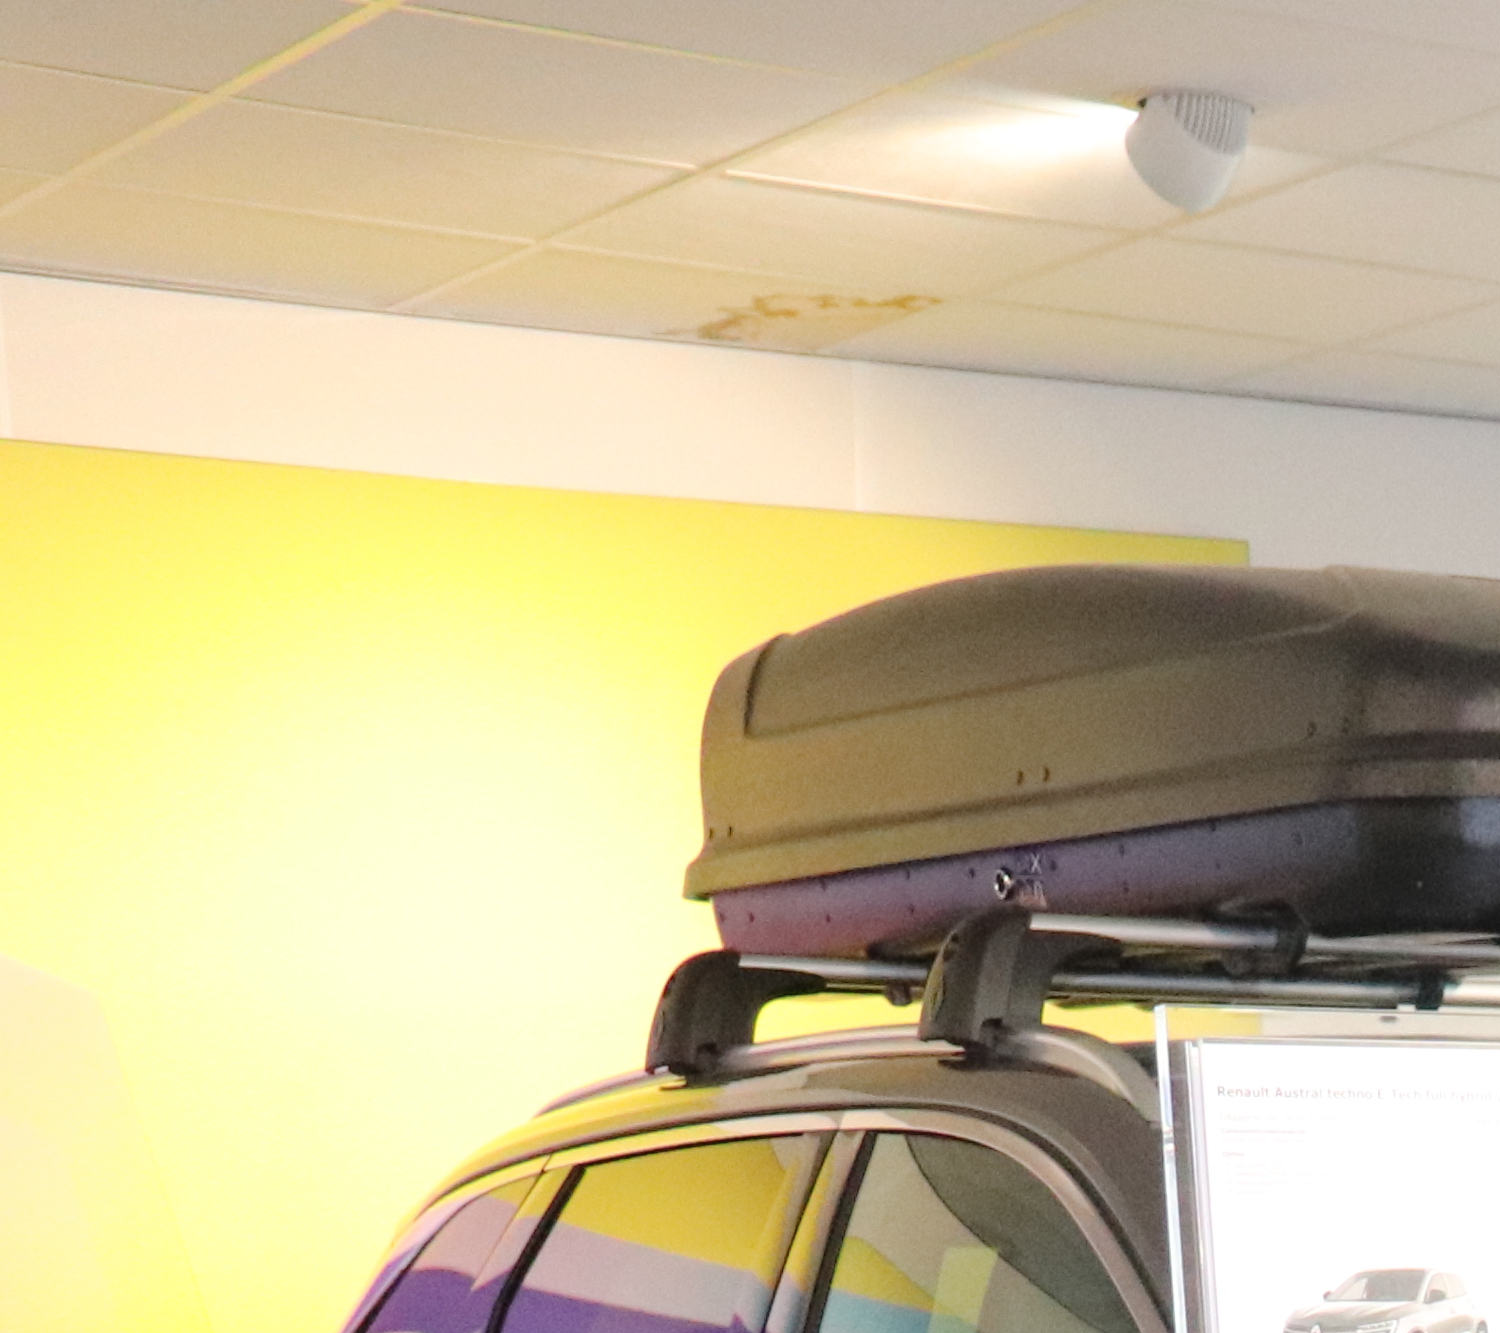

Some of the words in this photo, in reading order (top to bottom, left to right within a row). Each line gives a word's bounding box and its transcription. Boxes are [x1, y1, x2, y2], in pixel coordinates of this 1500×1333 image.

[1217, 1085, 1270, 1098] Renault
[1275, 1086, 1323, 1098] Austral
[1327, 1088, 1373, 1100] techno
[1426, 1089, 1446, 1101] full
